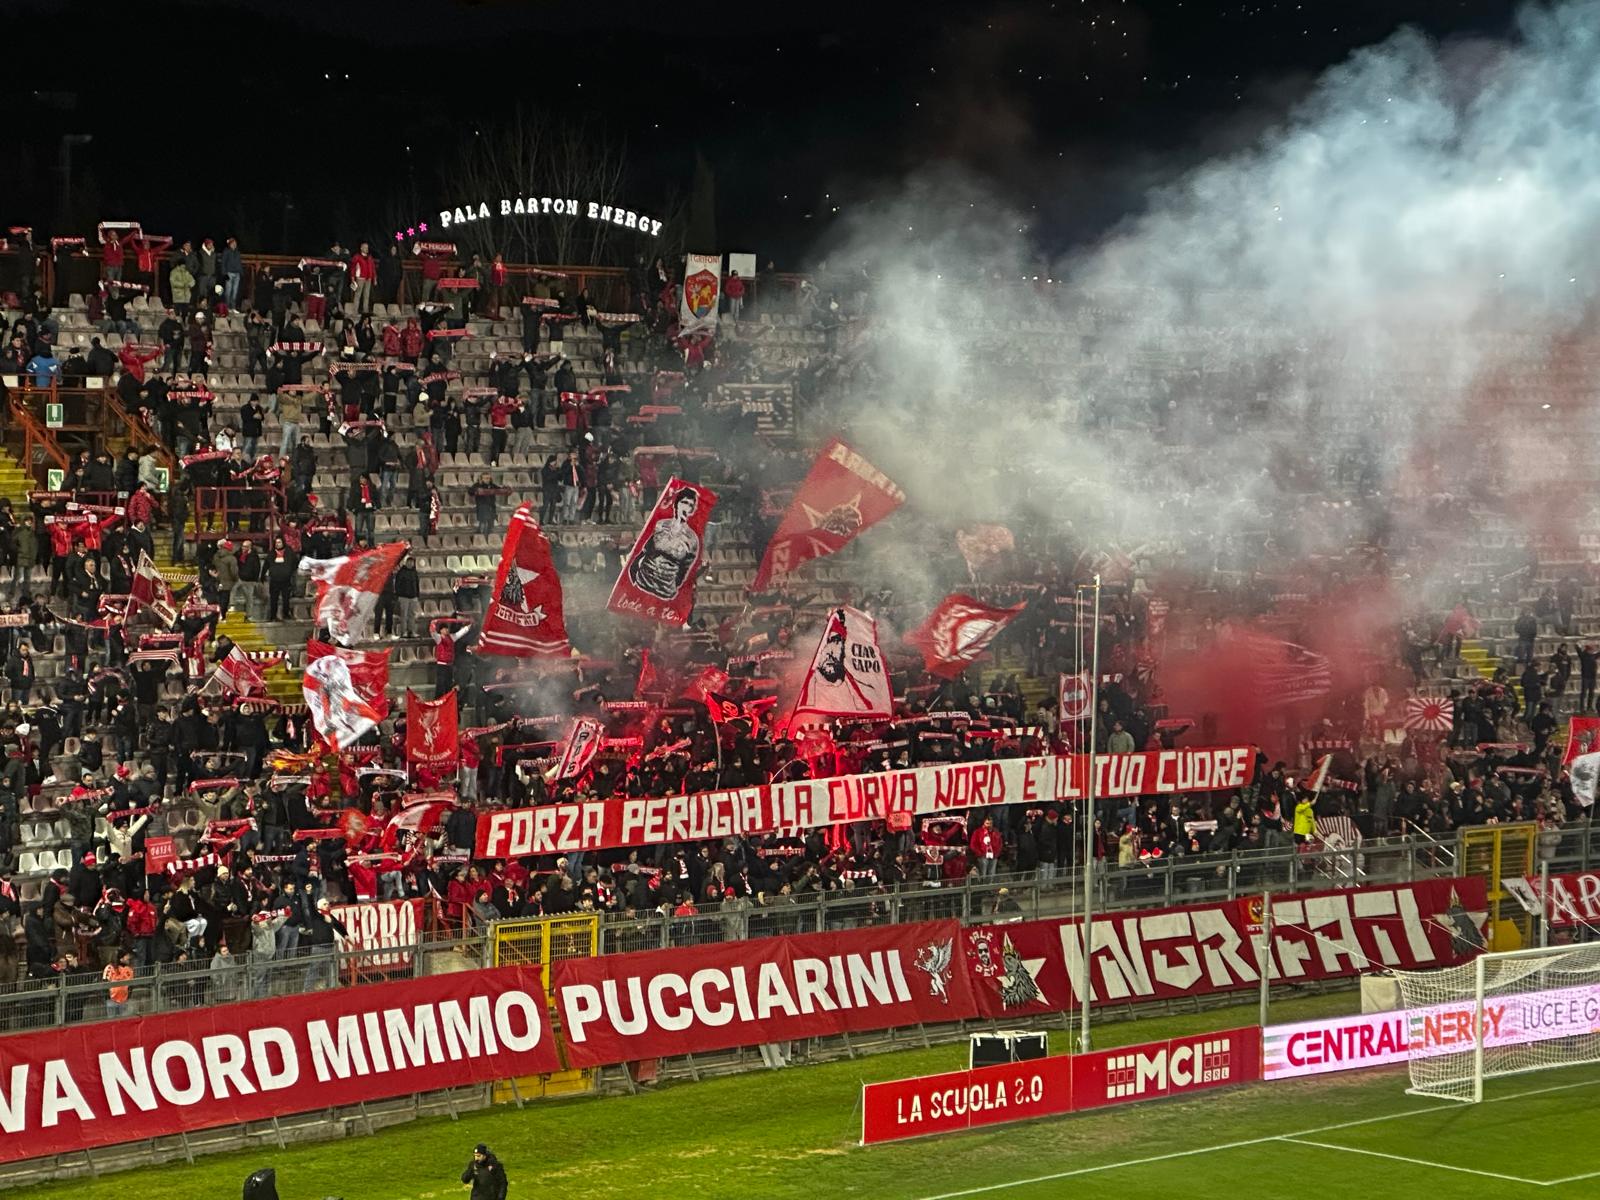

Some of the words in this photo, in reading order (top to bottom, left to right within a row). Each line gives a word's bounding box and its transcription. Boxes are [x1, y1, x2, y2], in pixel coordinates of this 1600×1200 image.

[440, 202, 491, 228] PALA
[500, 197, 579, 216] BARTON
[587, 202, 663, 236] ENERGY
[486, 802, 605, 857] FORZA
[621, 787, 763, 844] PERUGIA
[778, 784, 813, 828] LA
[828, 772, 917, 822] CURVA
[934, 763, 1006, 810] NORD
[1056, 758, 1081, 797] IL
[1094, 755, 1146, 797] TUO
[1156, 748, 1249, 792] CUORE
[561, 949, 913, 1043] PUCCIARINI
[1521, 1003, 1564, 1030] LUCE
[1569, 999, 1579, 1023] E
[99, 1026, 301, 1117] NORD
[306, 990, 542, 1083] MIMMO
[1135, 1043, 1203, 1094] MCI
[1204, 1067, 1229, 1081] SRL
[897, 1094, 923, 1124] LA
[930, 1081, 1008, 1119] SCUOLA
